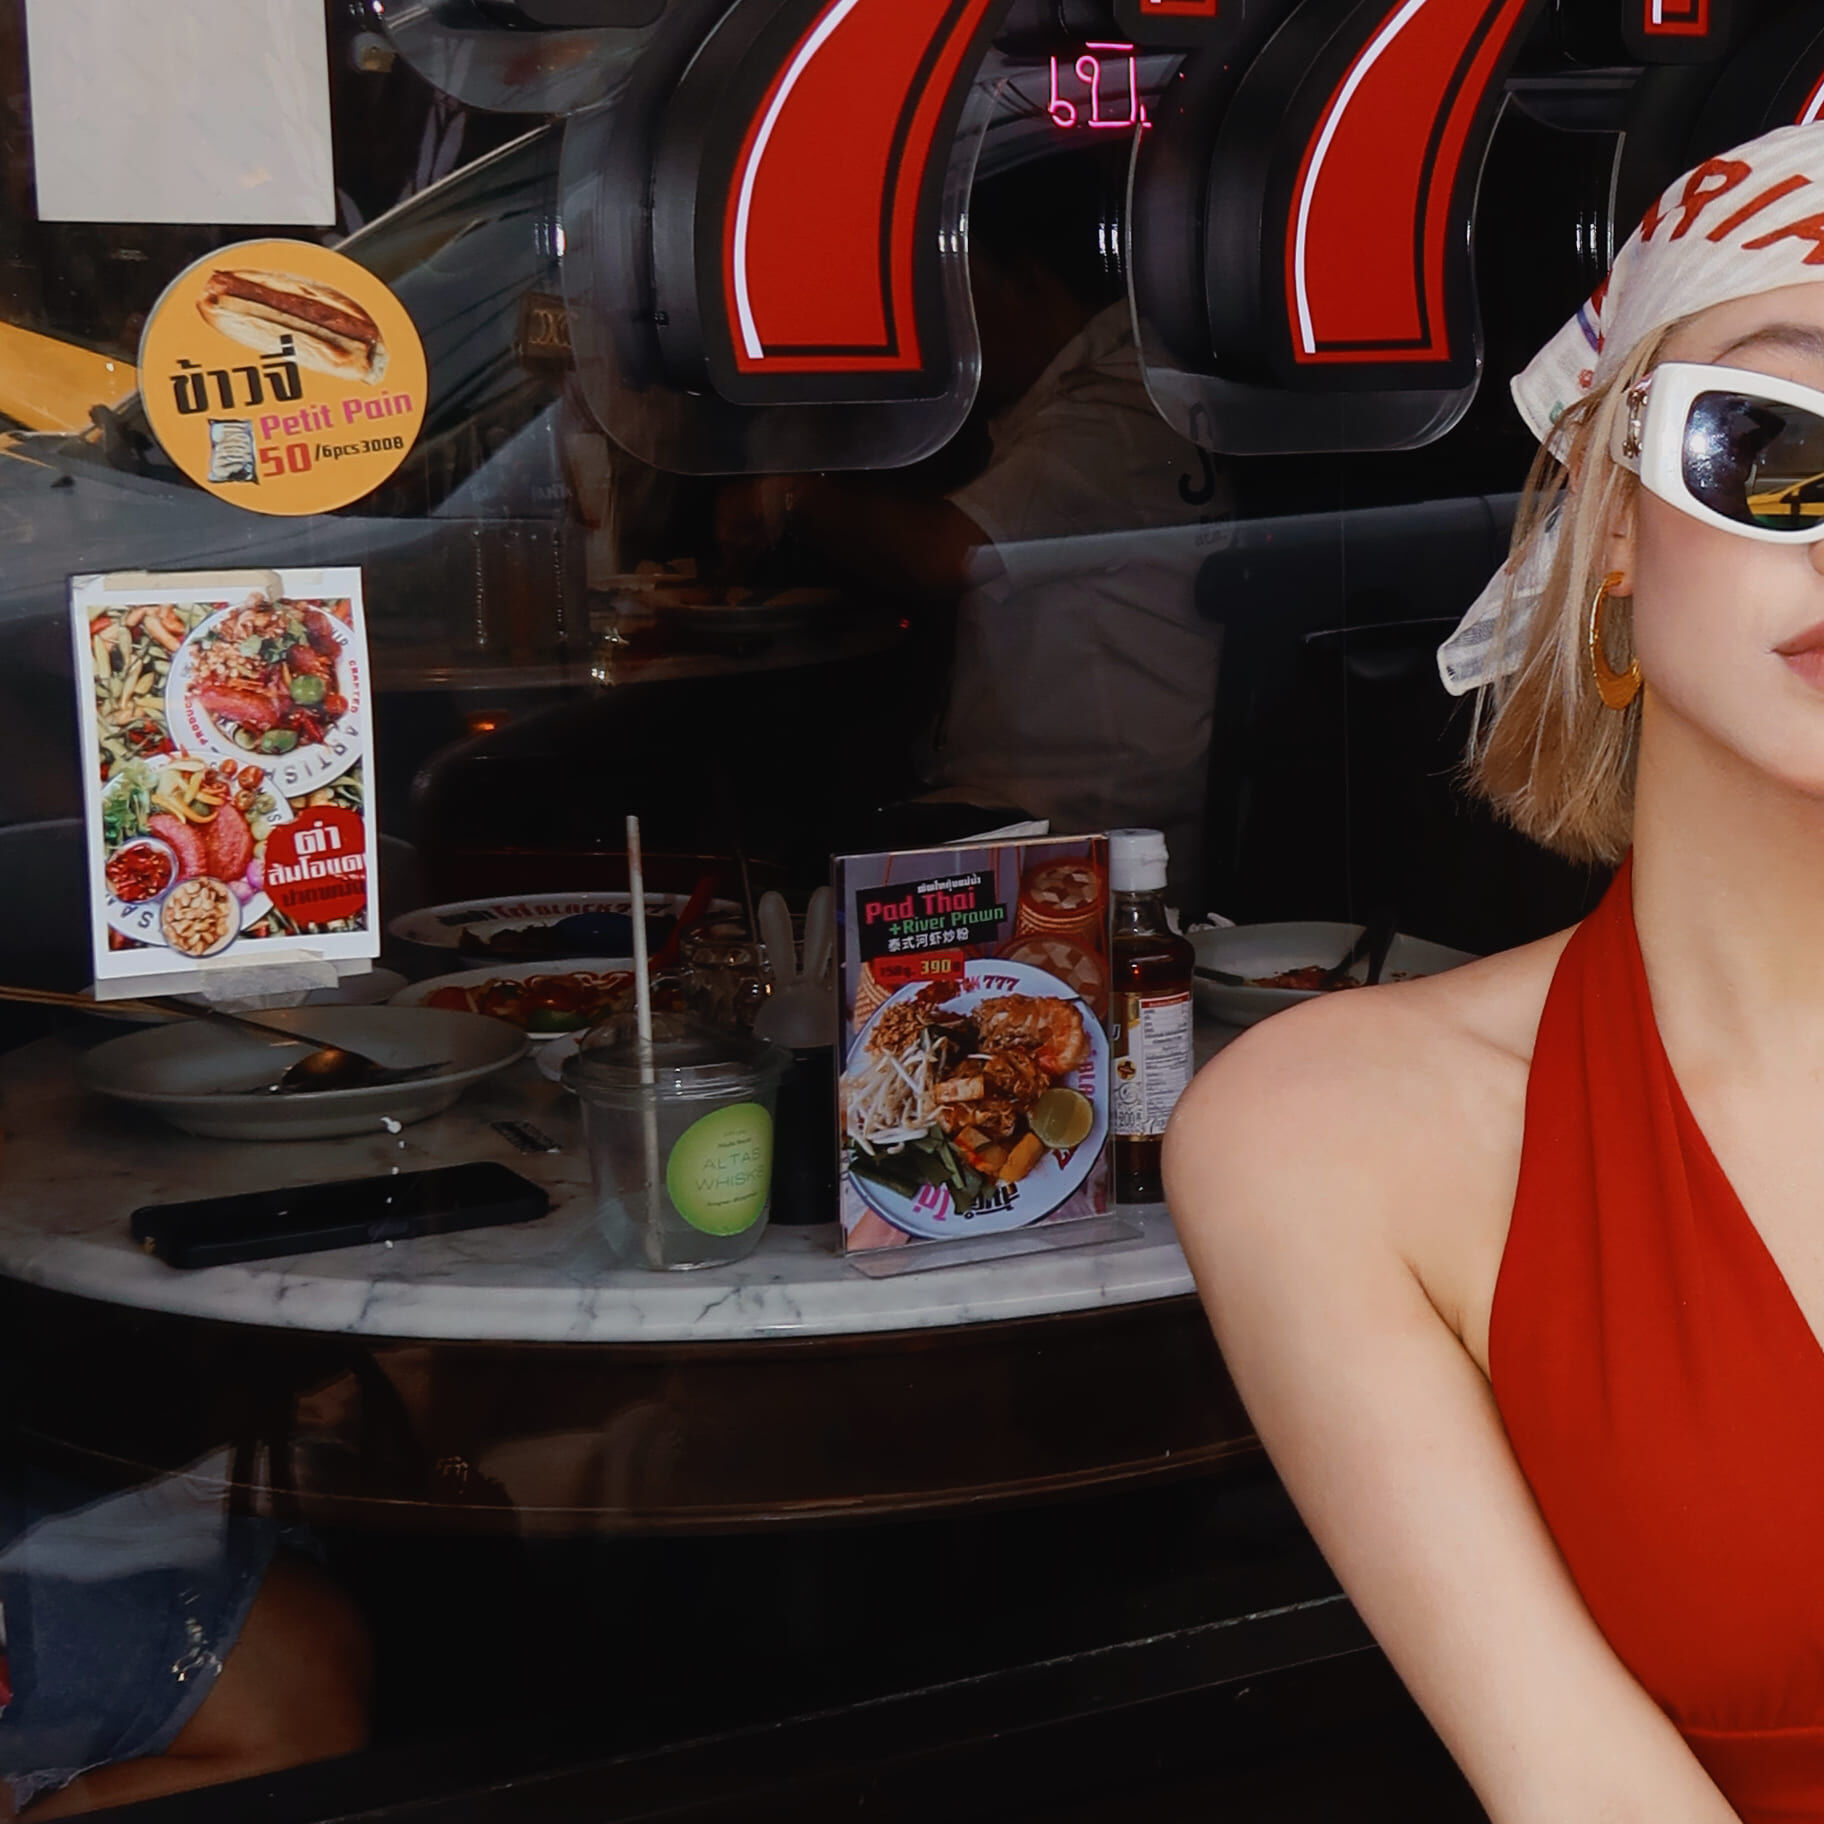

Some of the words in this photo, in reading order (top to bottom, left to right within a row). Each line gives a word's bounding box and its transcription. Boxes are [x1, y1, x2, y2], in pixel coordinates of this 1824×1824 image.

[1048, 41, 1153, 129] เปิ
[168, 333, 304, 416] ข้าวจี่
[259, 404, 335, 441] Petit
[341, 390, 413, 425] Pain
[258, 441, 313, 478] 50
[184, 694, 209, 746] PRODUCT
[865, 896, 915, 925] Pad
[923, 886, 976, 919] Thai
[889, 913, 946, 936] +River
[951, 907, 1004, 928] Prawn
[920, 958, 952, 975] 390
[982, 975, 1020, 992] 777
